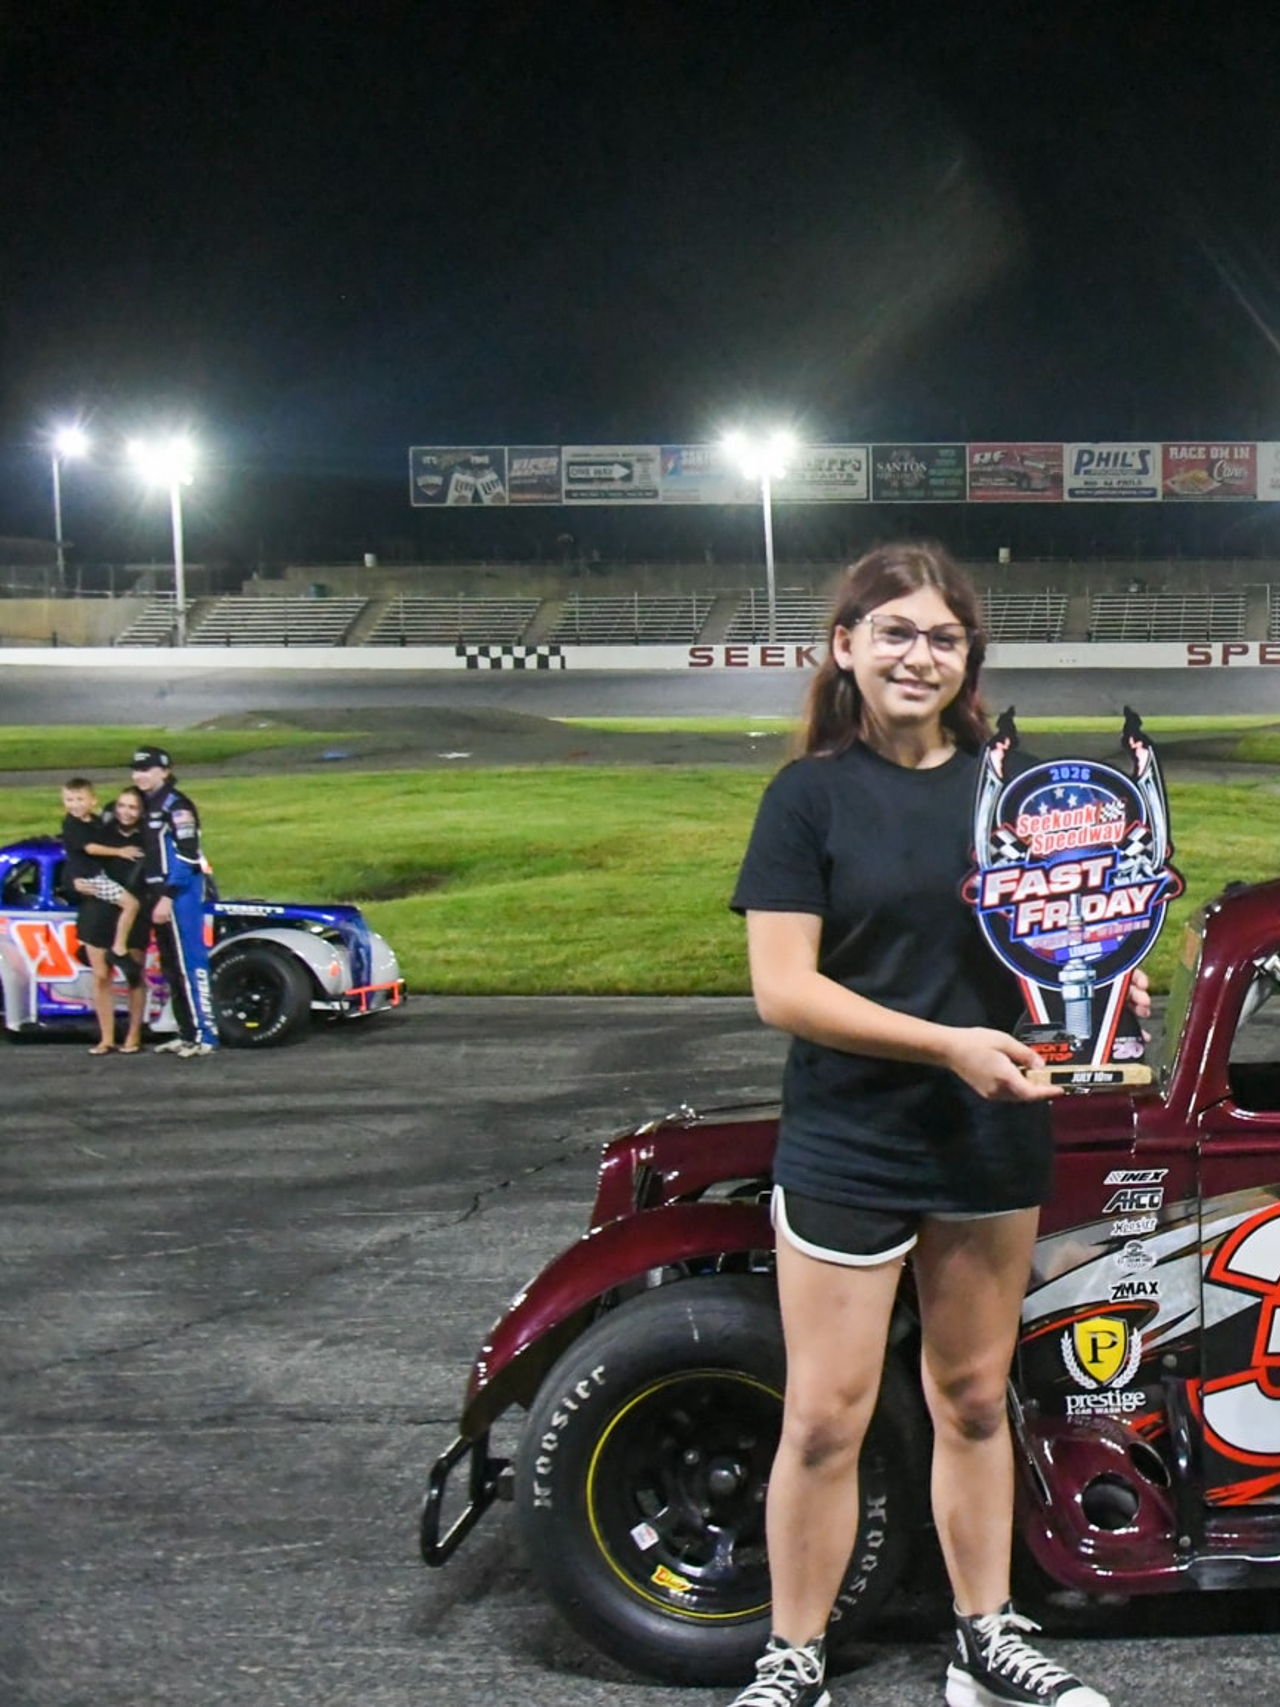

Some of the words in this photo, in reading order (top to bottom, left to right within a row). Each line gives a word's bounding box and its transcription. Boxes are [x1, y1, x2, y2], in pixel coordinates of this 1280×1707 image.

[1073, 449, 1150, 476] PHIL'S
[1168, 446, 1208, 460] RACE
[1233, 446, 1251, 460] IN
[876, 462, 928, 472] SANTOS
[688, 646, 819, 668] SEEK
[1049, 767, 1091, 781] 2026
[1016, 804, 1097, 837] Seekonk
[1030, 821, 1125, 855] Speedway
[982, 856, 1113, 907] FAST
[1120, 1171, 1165, 1183] INEX
[1104, 1189, 1163, 1211] AFCO
[1086, 1330, 1118, 1364] P
[1065, 1390, 1147, 1415] prestige
[532, 1364, 606, 1508] Hoosier
[829, 1493, 888, 1623] Hoosie
